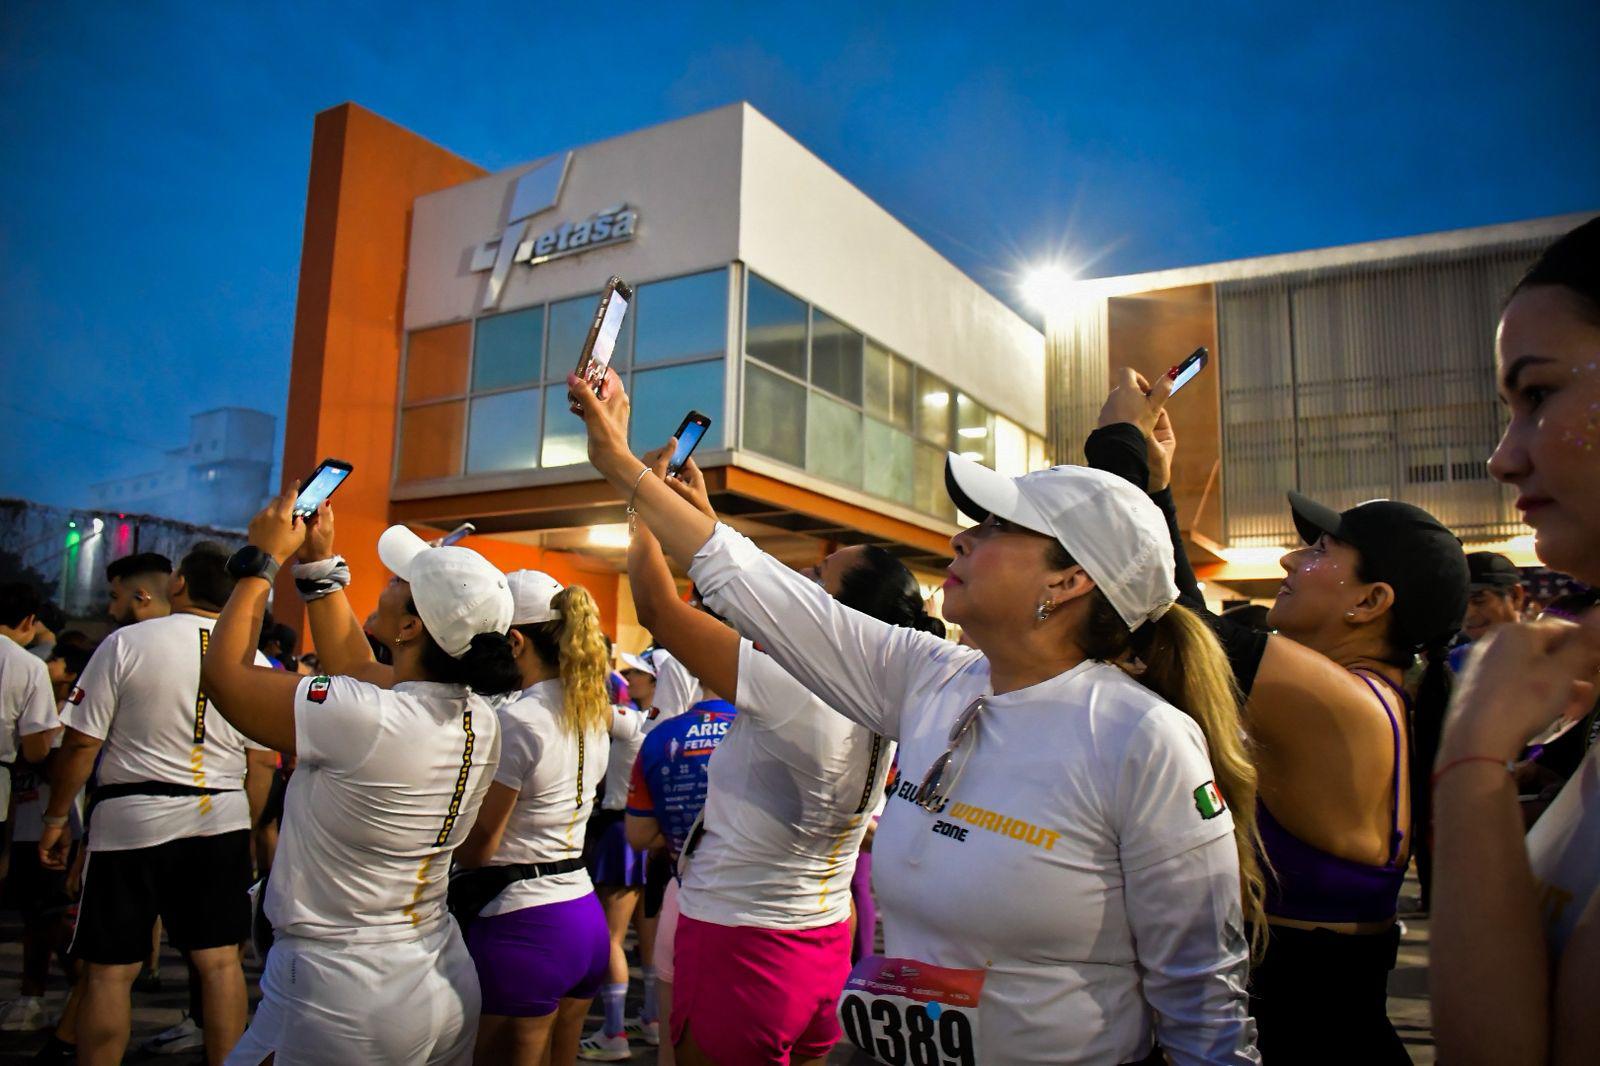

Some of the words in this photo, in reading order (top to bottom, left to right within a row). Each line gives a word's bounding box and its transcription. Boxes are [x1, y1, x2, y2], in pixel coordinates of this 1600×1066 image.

[932, 819, 970, 843] ZONE
[949, 801, 1061, 850] WORKOUT
[841, 994, 976, 1066] 0389
